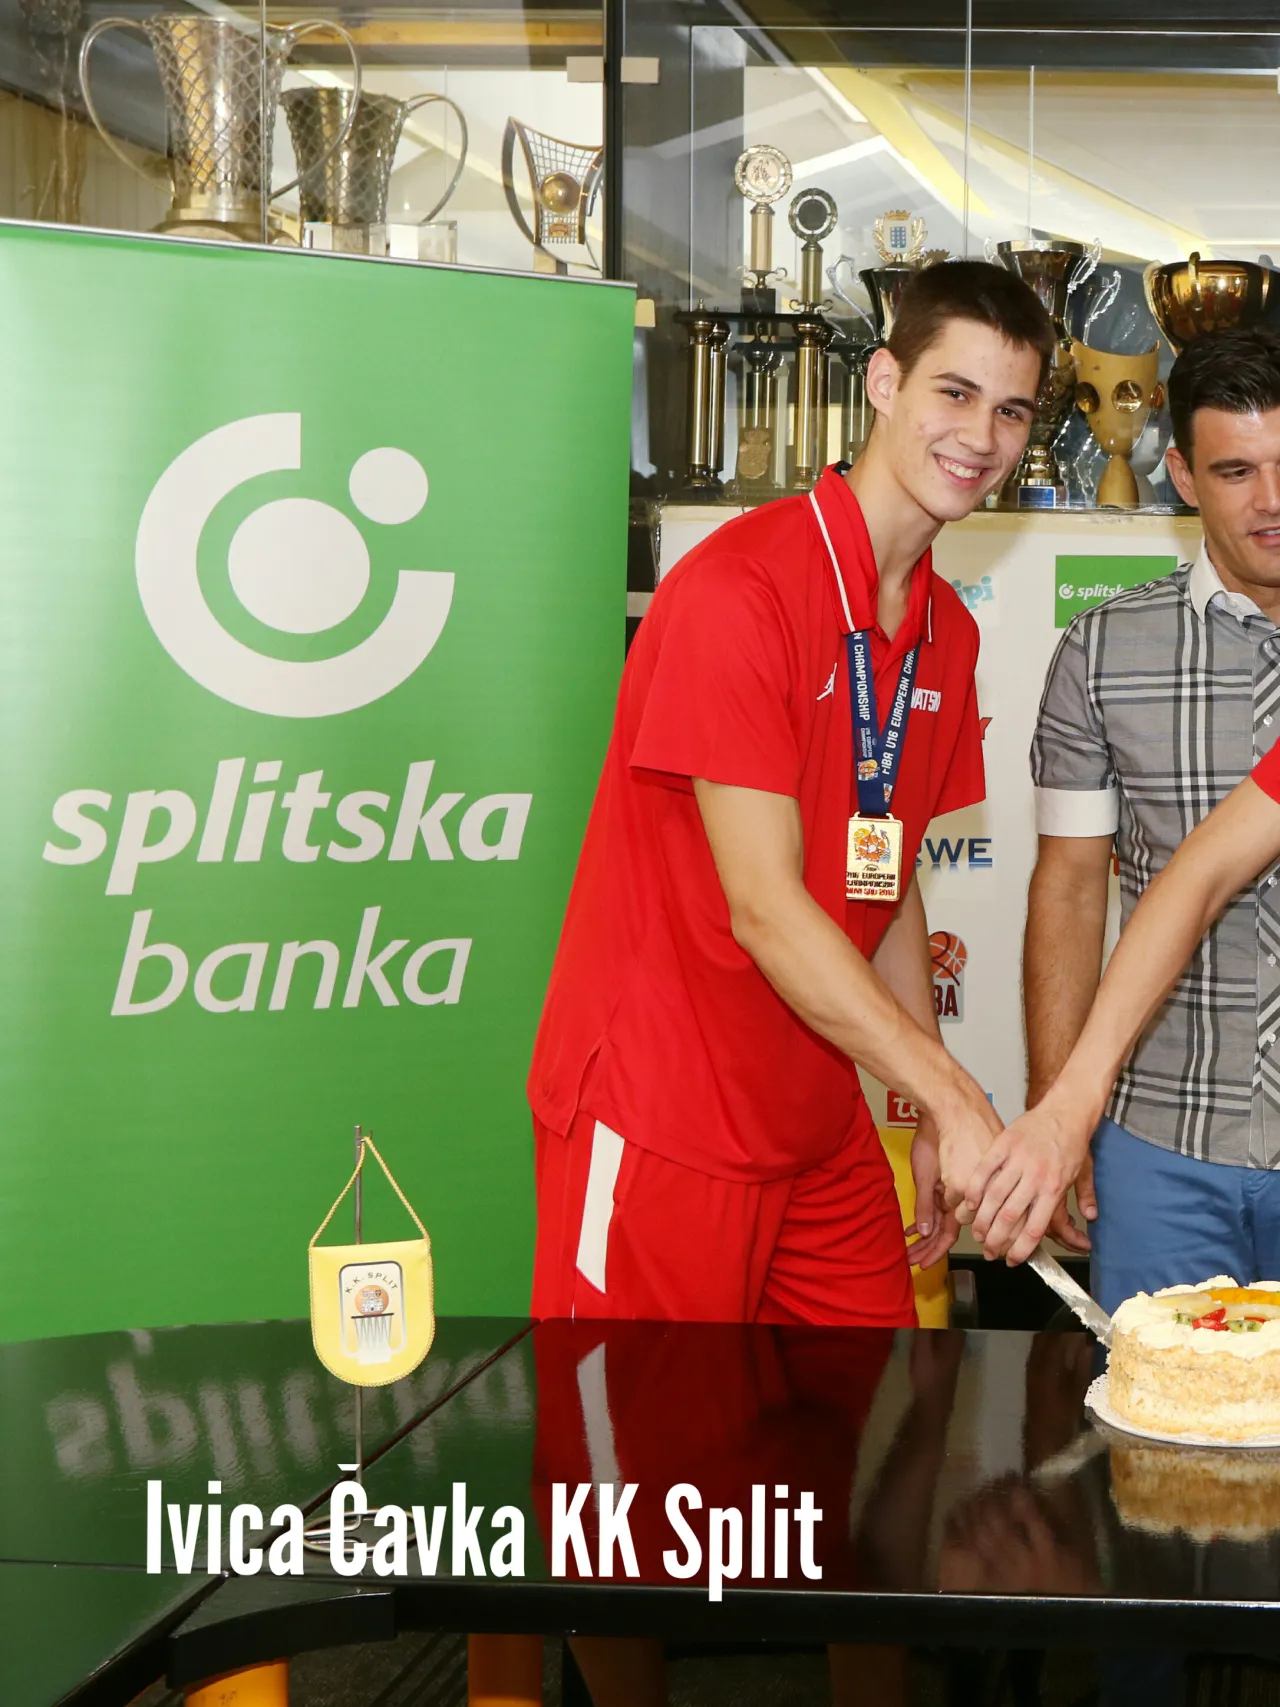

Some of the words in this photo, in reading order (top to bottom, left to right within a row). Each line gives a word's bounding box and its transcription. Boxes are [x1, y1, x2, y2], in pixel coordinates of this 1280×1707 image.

[854, 644, 871, 721] CHAMPIONSHIP
[890, 677, 910, 728] EUROPEAN
[885, 730, 899, 749] U16
[42, 756, 533, 896] splitska
[916, 838, 993, 863] WE
[110, 904, 473, 1017] banka
[367, 1272, 398, 1290] SPLIT
